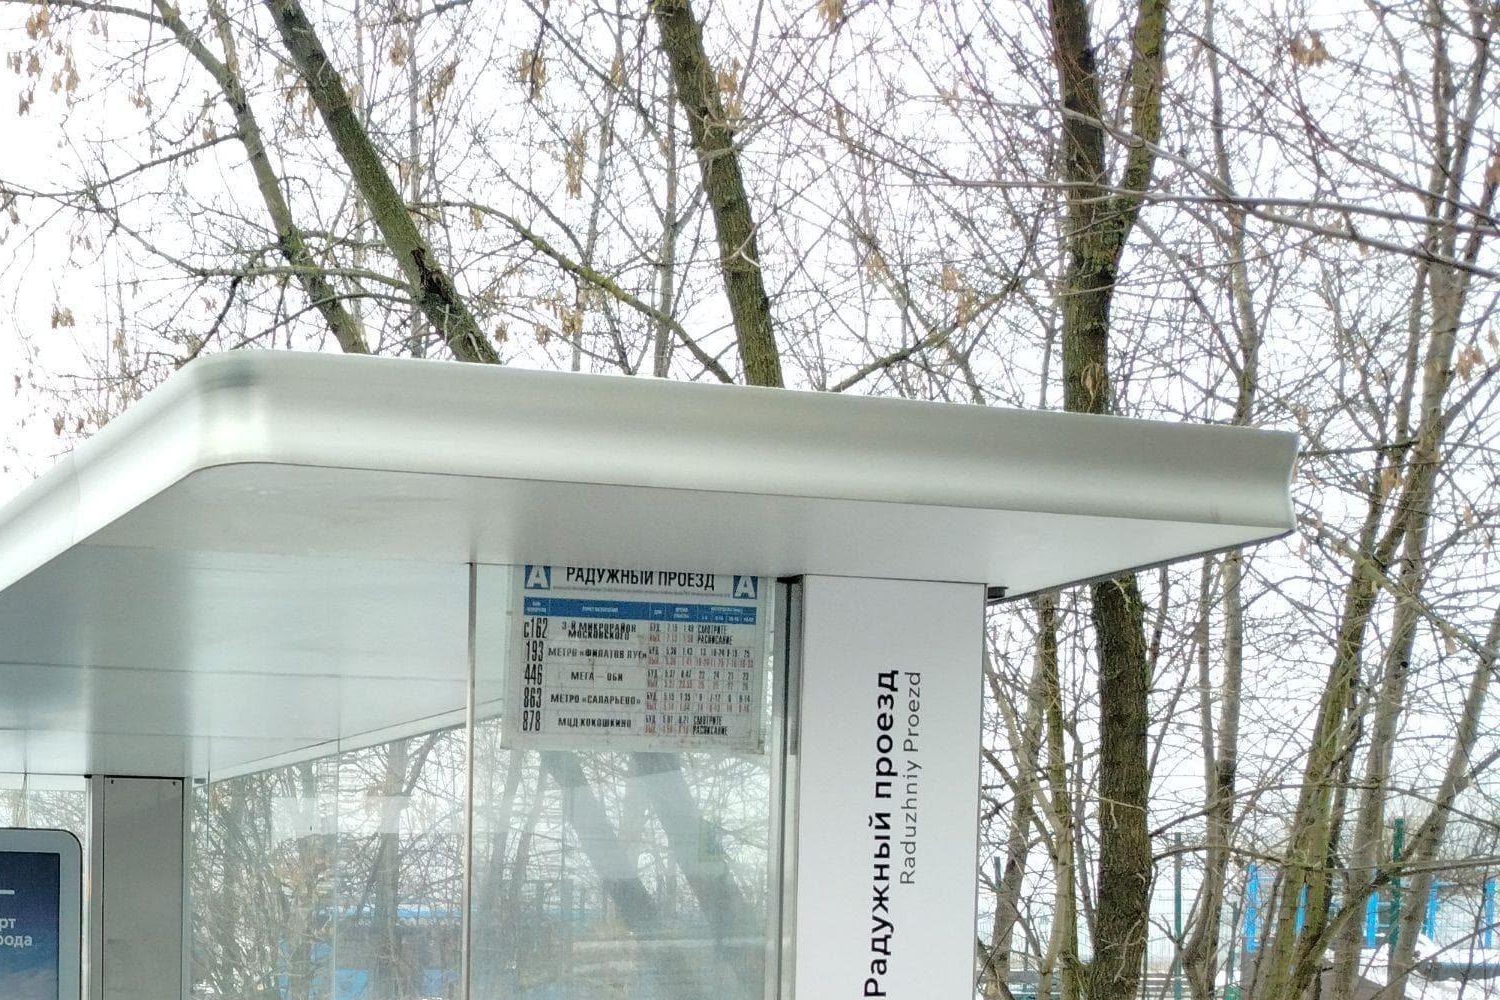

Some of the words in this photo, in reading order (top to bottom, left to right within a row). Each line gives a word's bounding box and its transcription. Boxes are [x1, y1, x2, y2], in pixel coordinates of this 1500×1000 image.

[566, 566, 654, 586] РАДУЖНЫЙ
[658, 571, 715, 591] ПРОЕЗД
[568, 630, 630, 640] МОСКОВСКОГО
[526, 640, 544, 662] 193
[548, 647, 577, 657] МЕТРО
[523, 663, 543, 685] 446
[570, 671, 595, 681] МЕГА
[523, 687, 542, 708] 863
[550, 693, 580, 703] МЕТРО
[522, 710, 541, 732] 878
[903, 671, 921, 752] Proezd
[875, 669, 899, 799] проезд
[899, 759, 922, 885] Raduzhniy
[863, 812, 894, 998] Радужный
